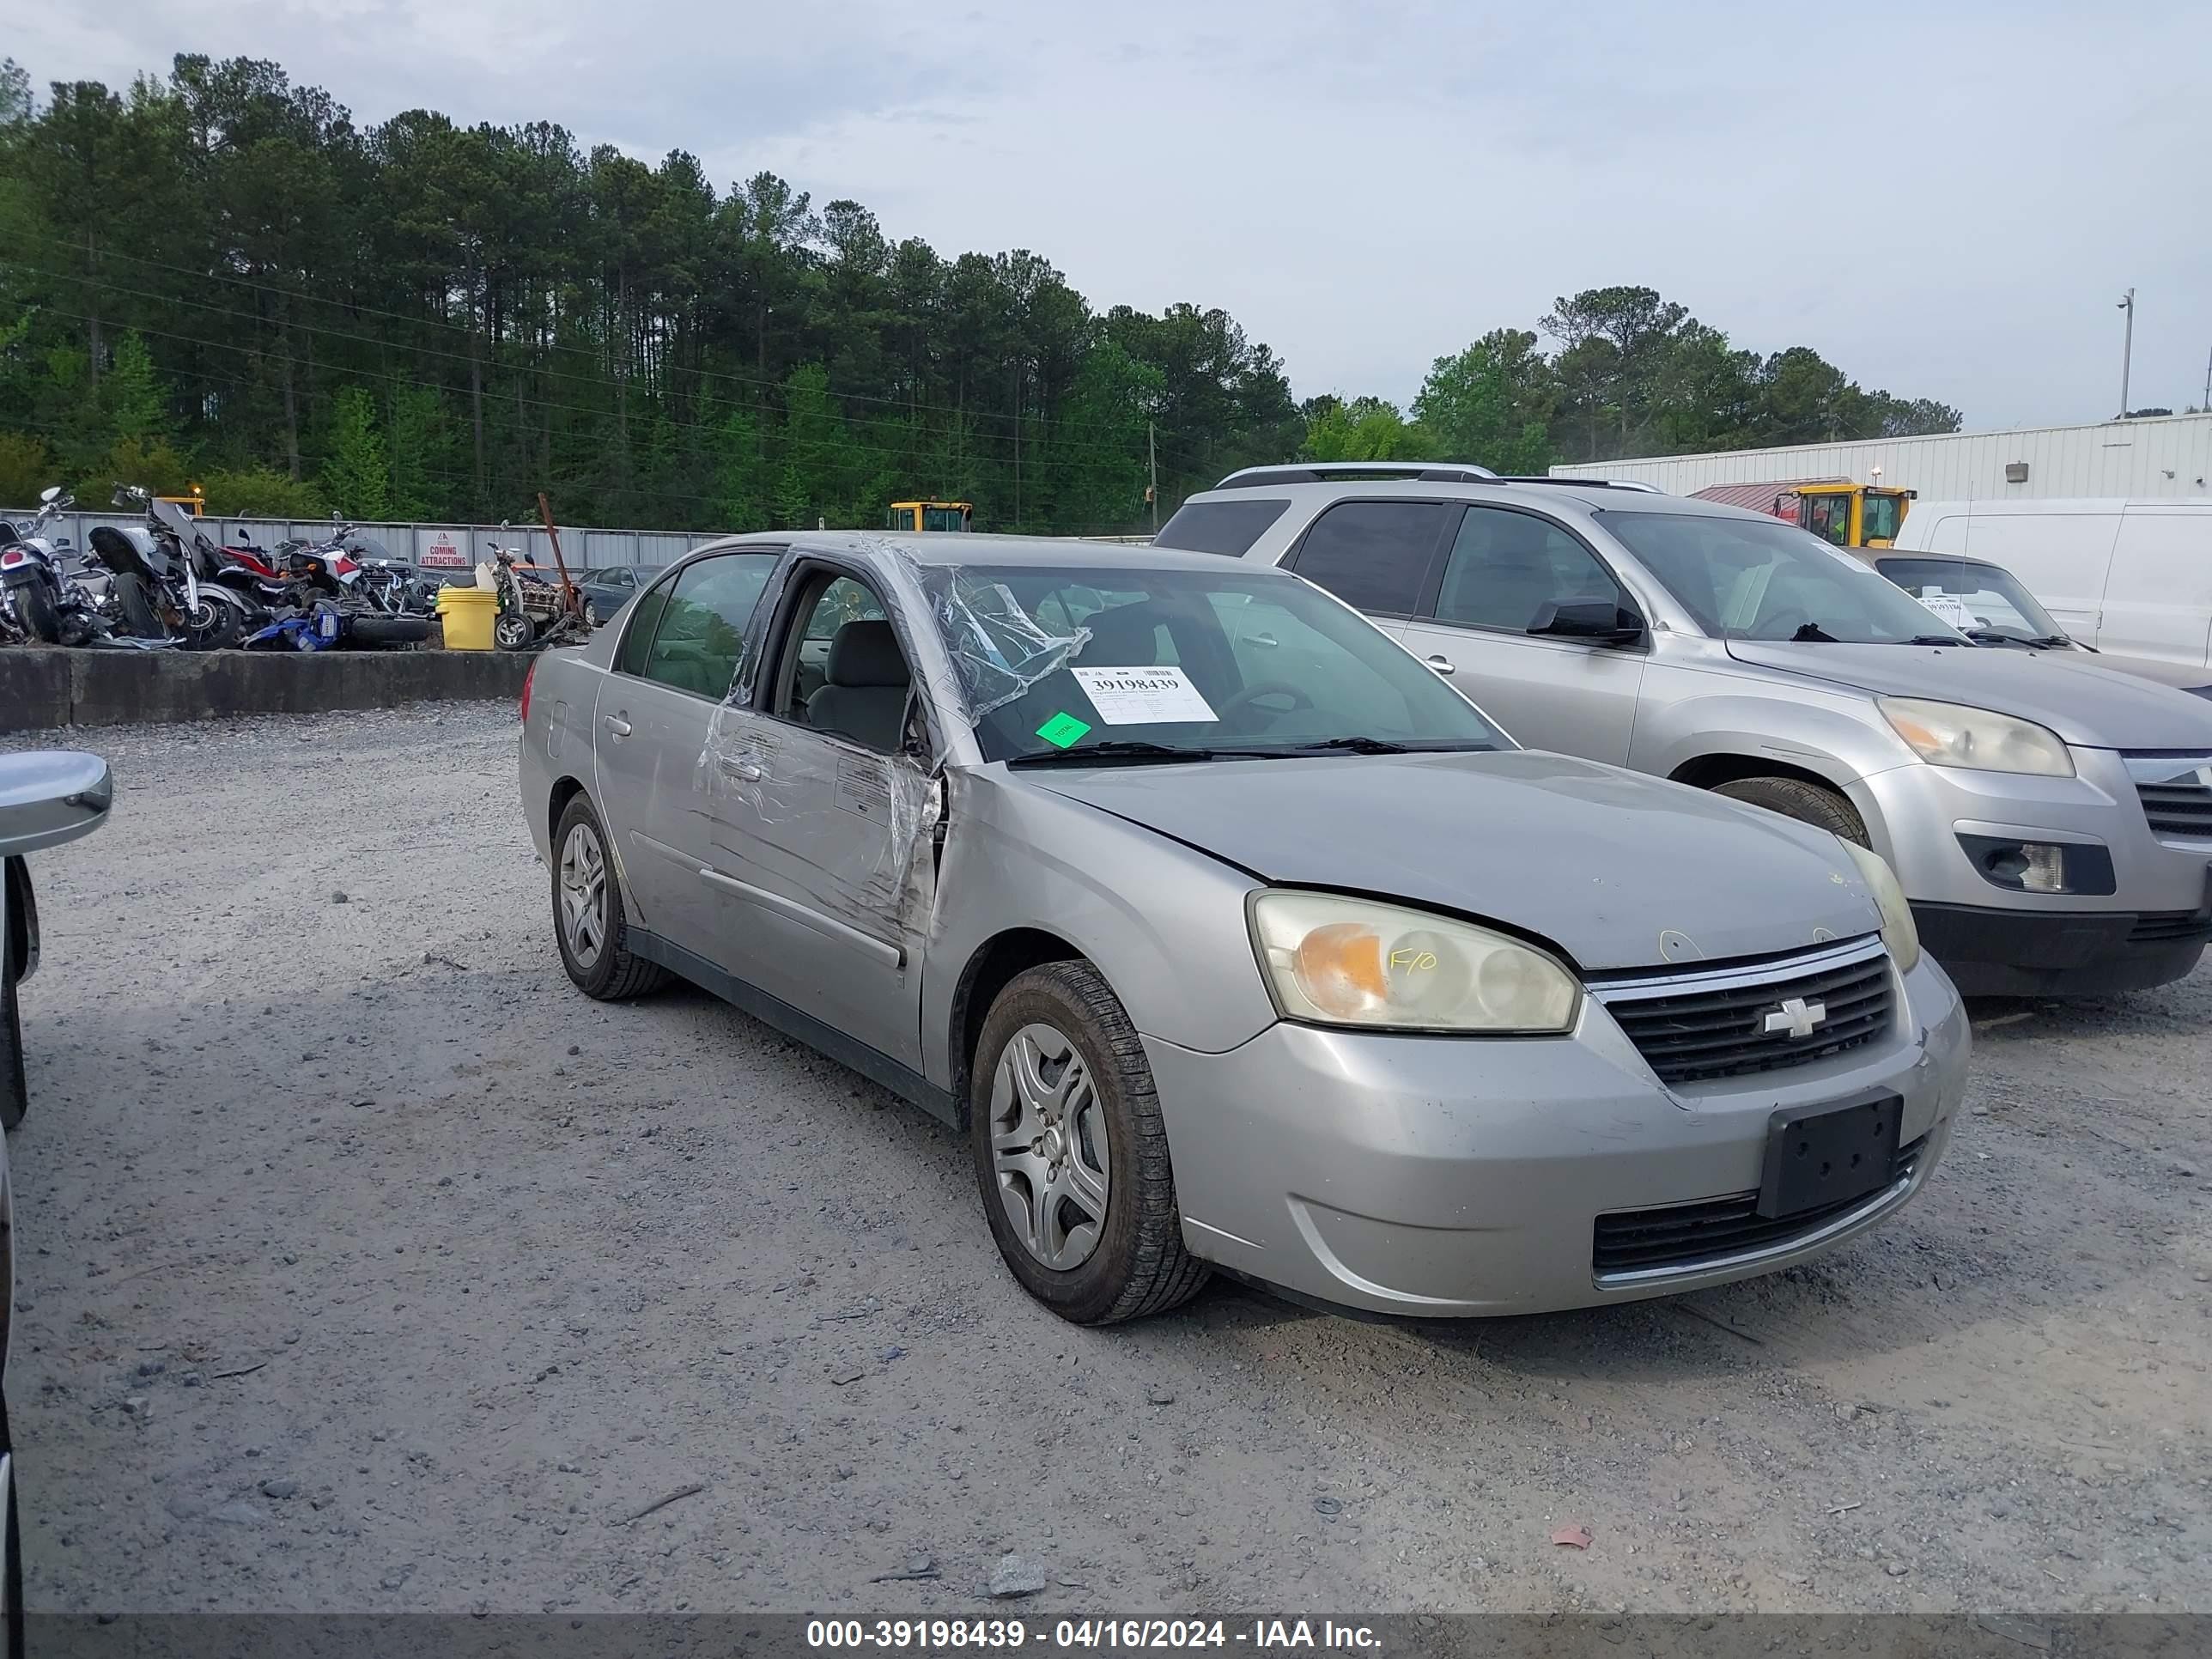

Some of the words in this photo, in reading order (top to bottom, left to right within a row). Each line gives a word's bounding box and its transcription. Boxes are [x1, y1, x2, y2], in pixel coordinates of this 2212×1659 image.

[430, 545, 457, 556] COMING
[421, 556, 466, 566] ATTRACTIONS
[1091, 679, 1179, 691] 39198439
[1054, 724, 1073, 737] TOTAL
